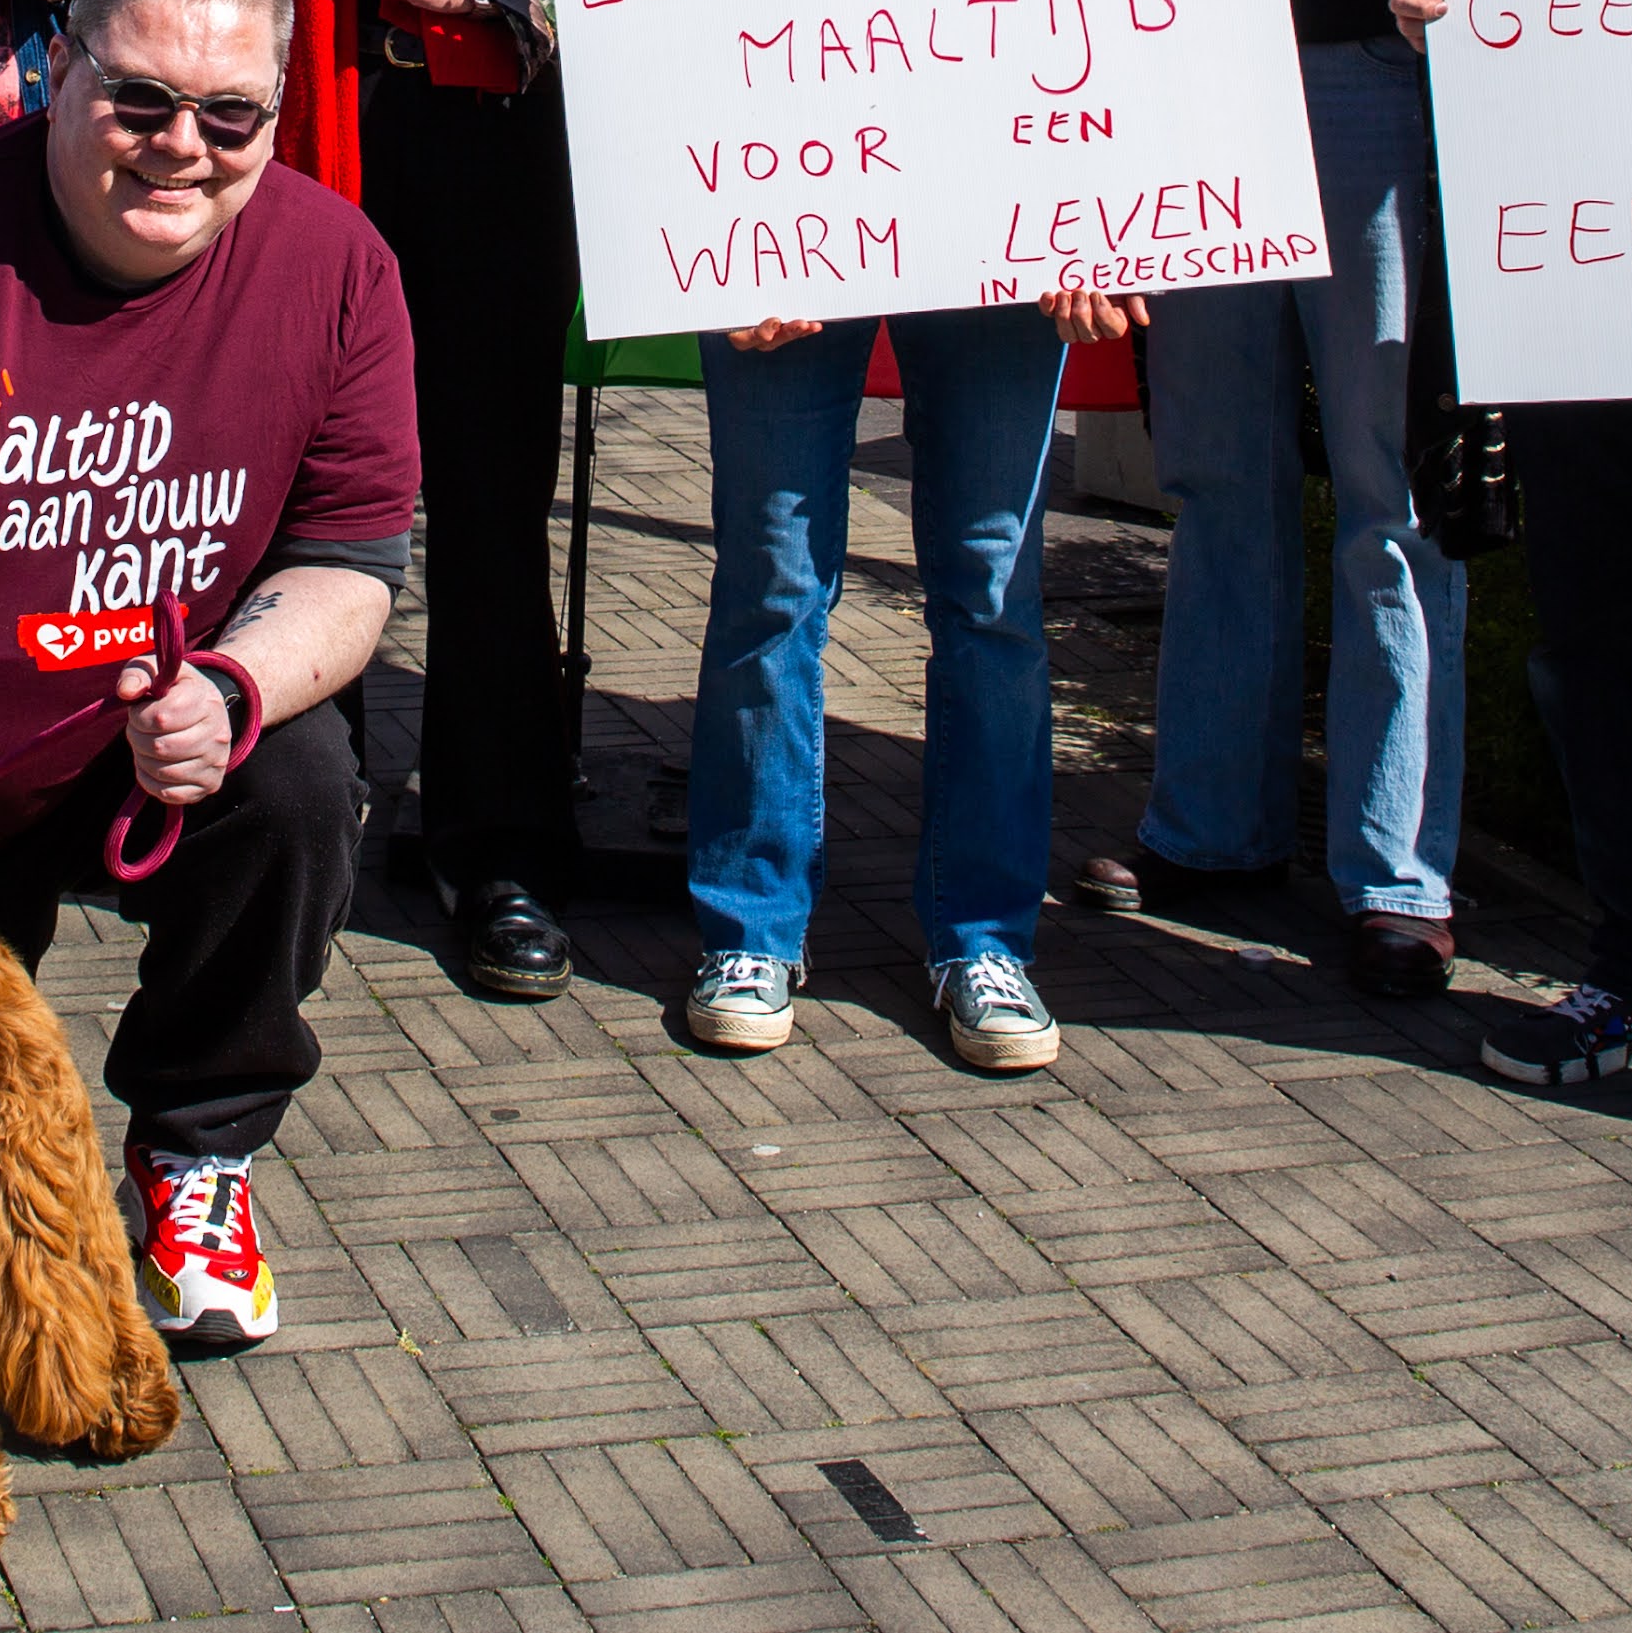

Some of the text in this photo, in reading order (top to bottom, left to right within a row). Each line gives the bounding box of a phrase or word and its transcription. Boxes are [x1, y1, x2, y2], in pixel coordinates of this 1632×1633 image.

[686, 108, 1114, 194] VOOR EEN
[660, 176, 1243, 294] WARM LEVEN
[105, 468, 247, 541] jouw
[93, 620, 156, 651] pvd
